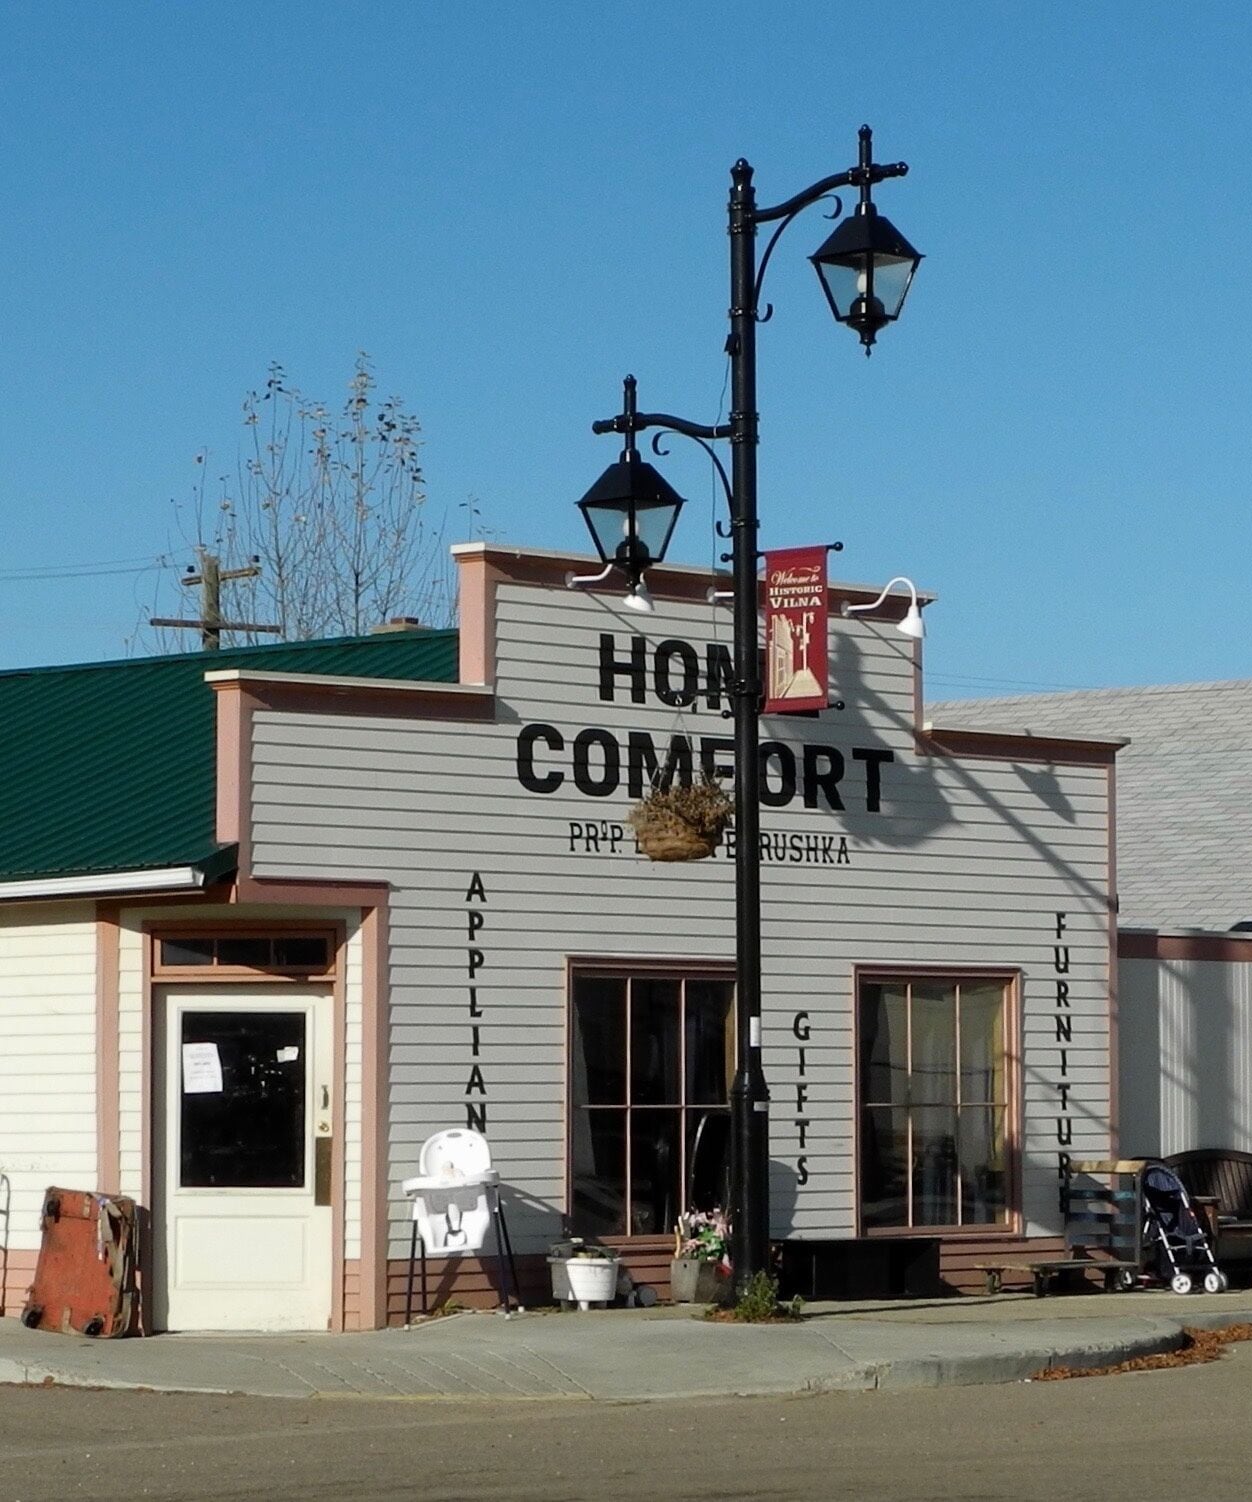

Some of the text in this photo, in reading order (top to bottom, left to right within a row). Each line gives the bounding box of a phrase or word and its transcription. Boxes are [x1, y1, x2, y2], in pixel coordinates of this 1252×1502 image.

[771, 568, 809, 586] Welcome
[769, 585, 823, 597] HISTORIC
[769, 596, 823, 609] VILNA
[793, 1011, 811, 1186] GIFTS
